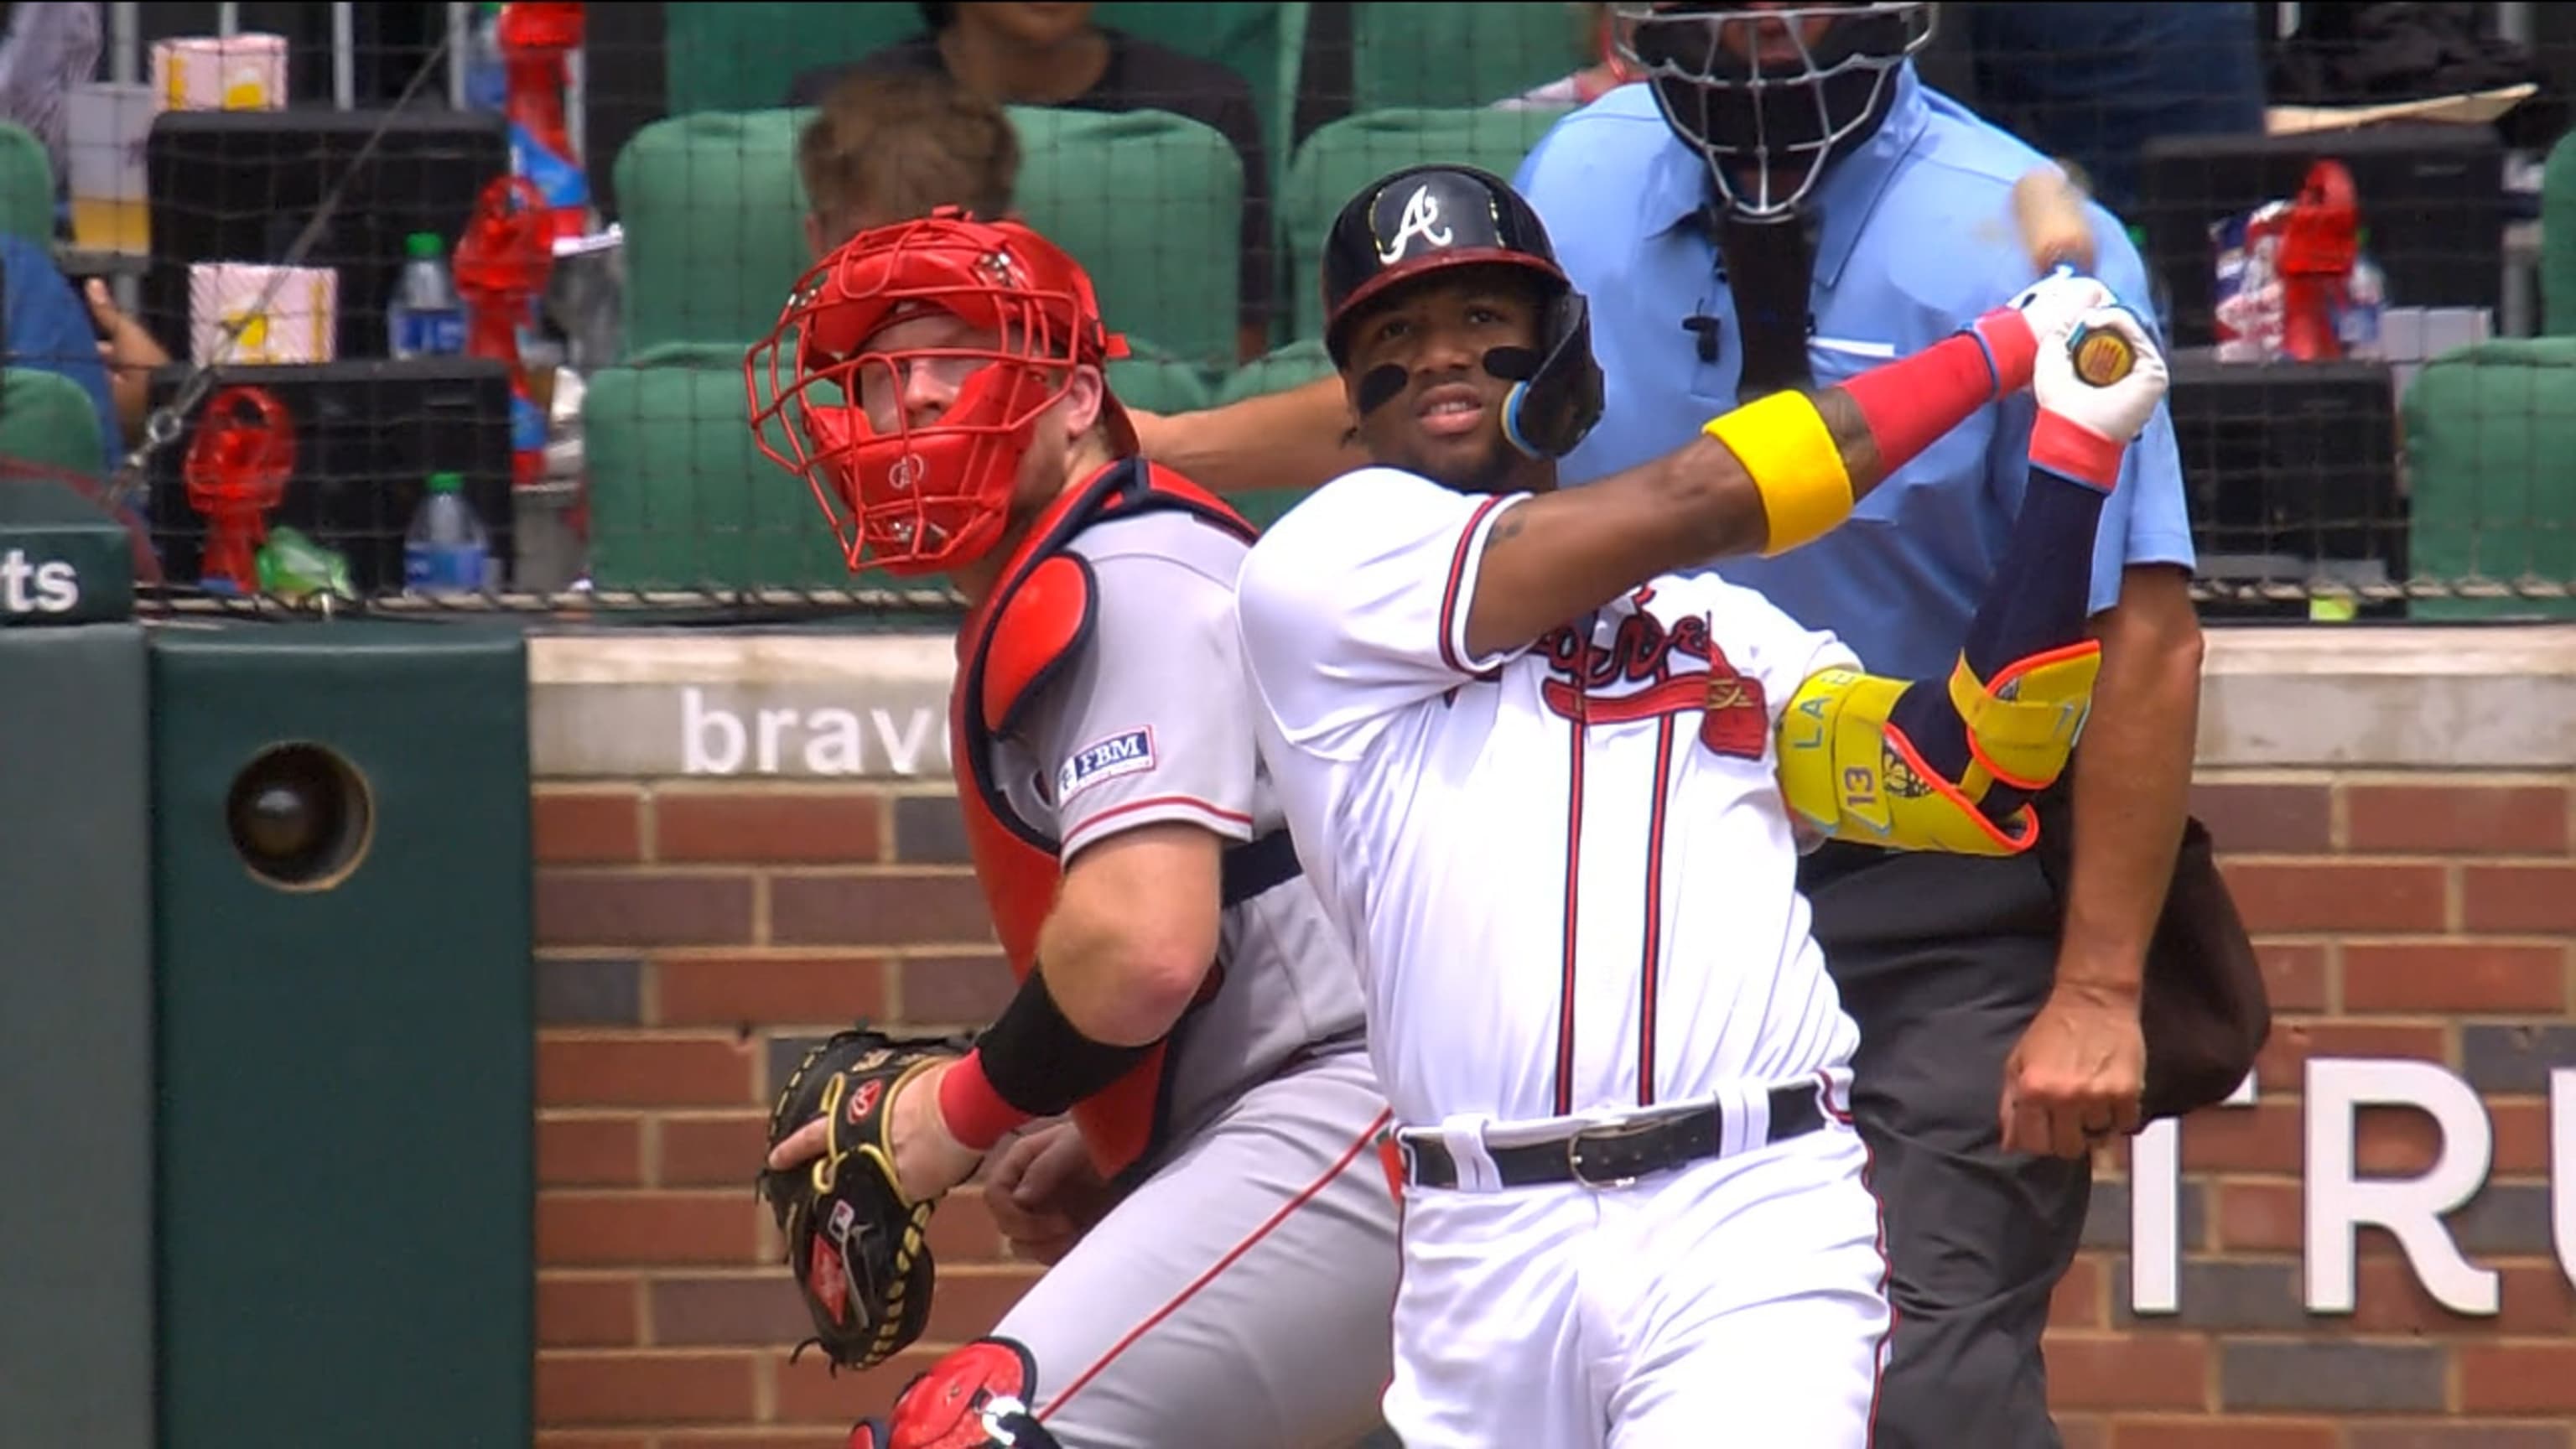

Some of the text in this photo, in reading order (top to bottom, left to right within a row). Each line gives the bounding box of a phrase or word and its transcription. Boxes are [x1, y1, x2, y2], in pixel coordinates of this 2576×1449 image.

[1379, 184, 1453, 265] A
[681, 687, 953, 776] brav
[1079, 735, 1141, 775] FBM
[1844, 766, 1877, 806] 13
[2132, 1057, 2576, 1316] TR
